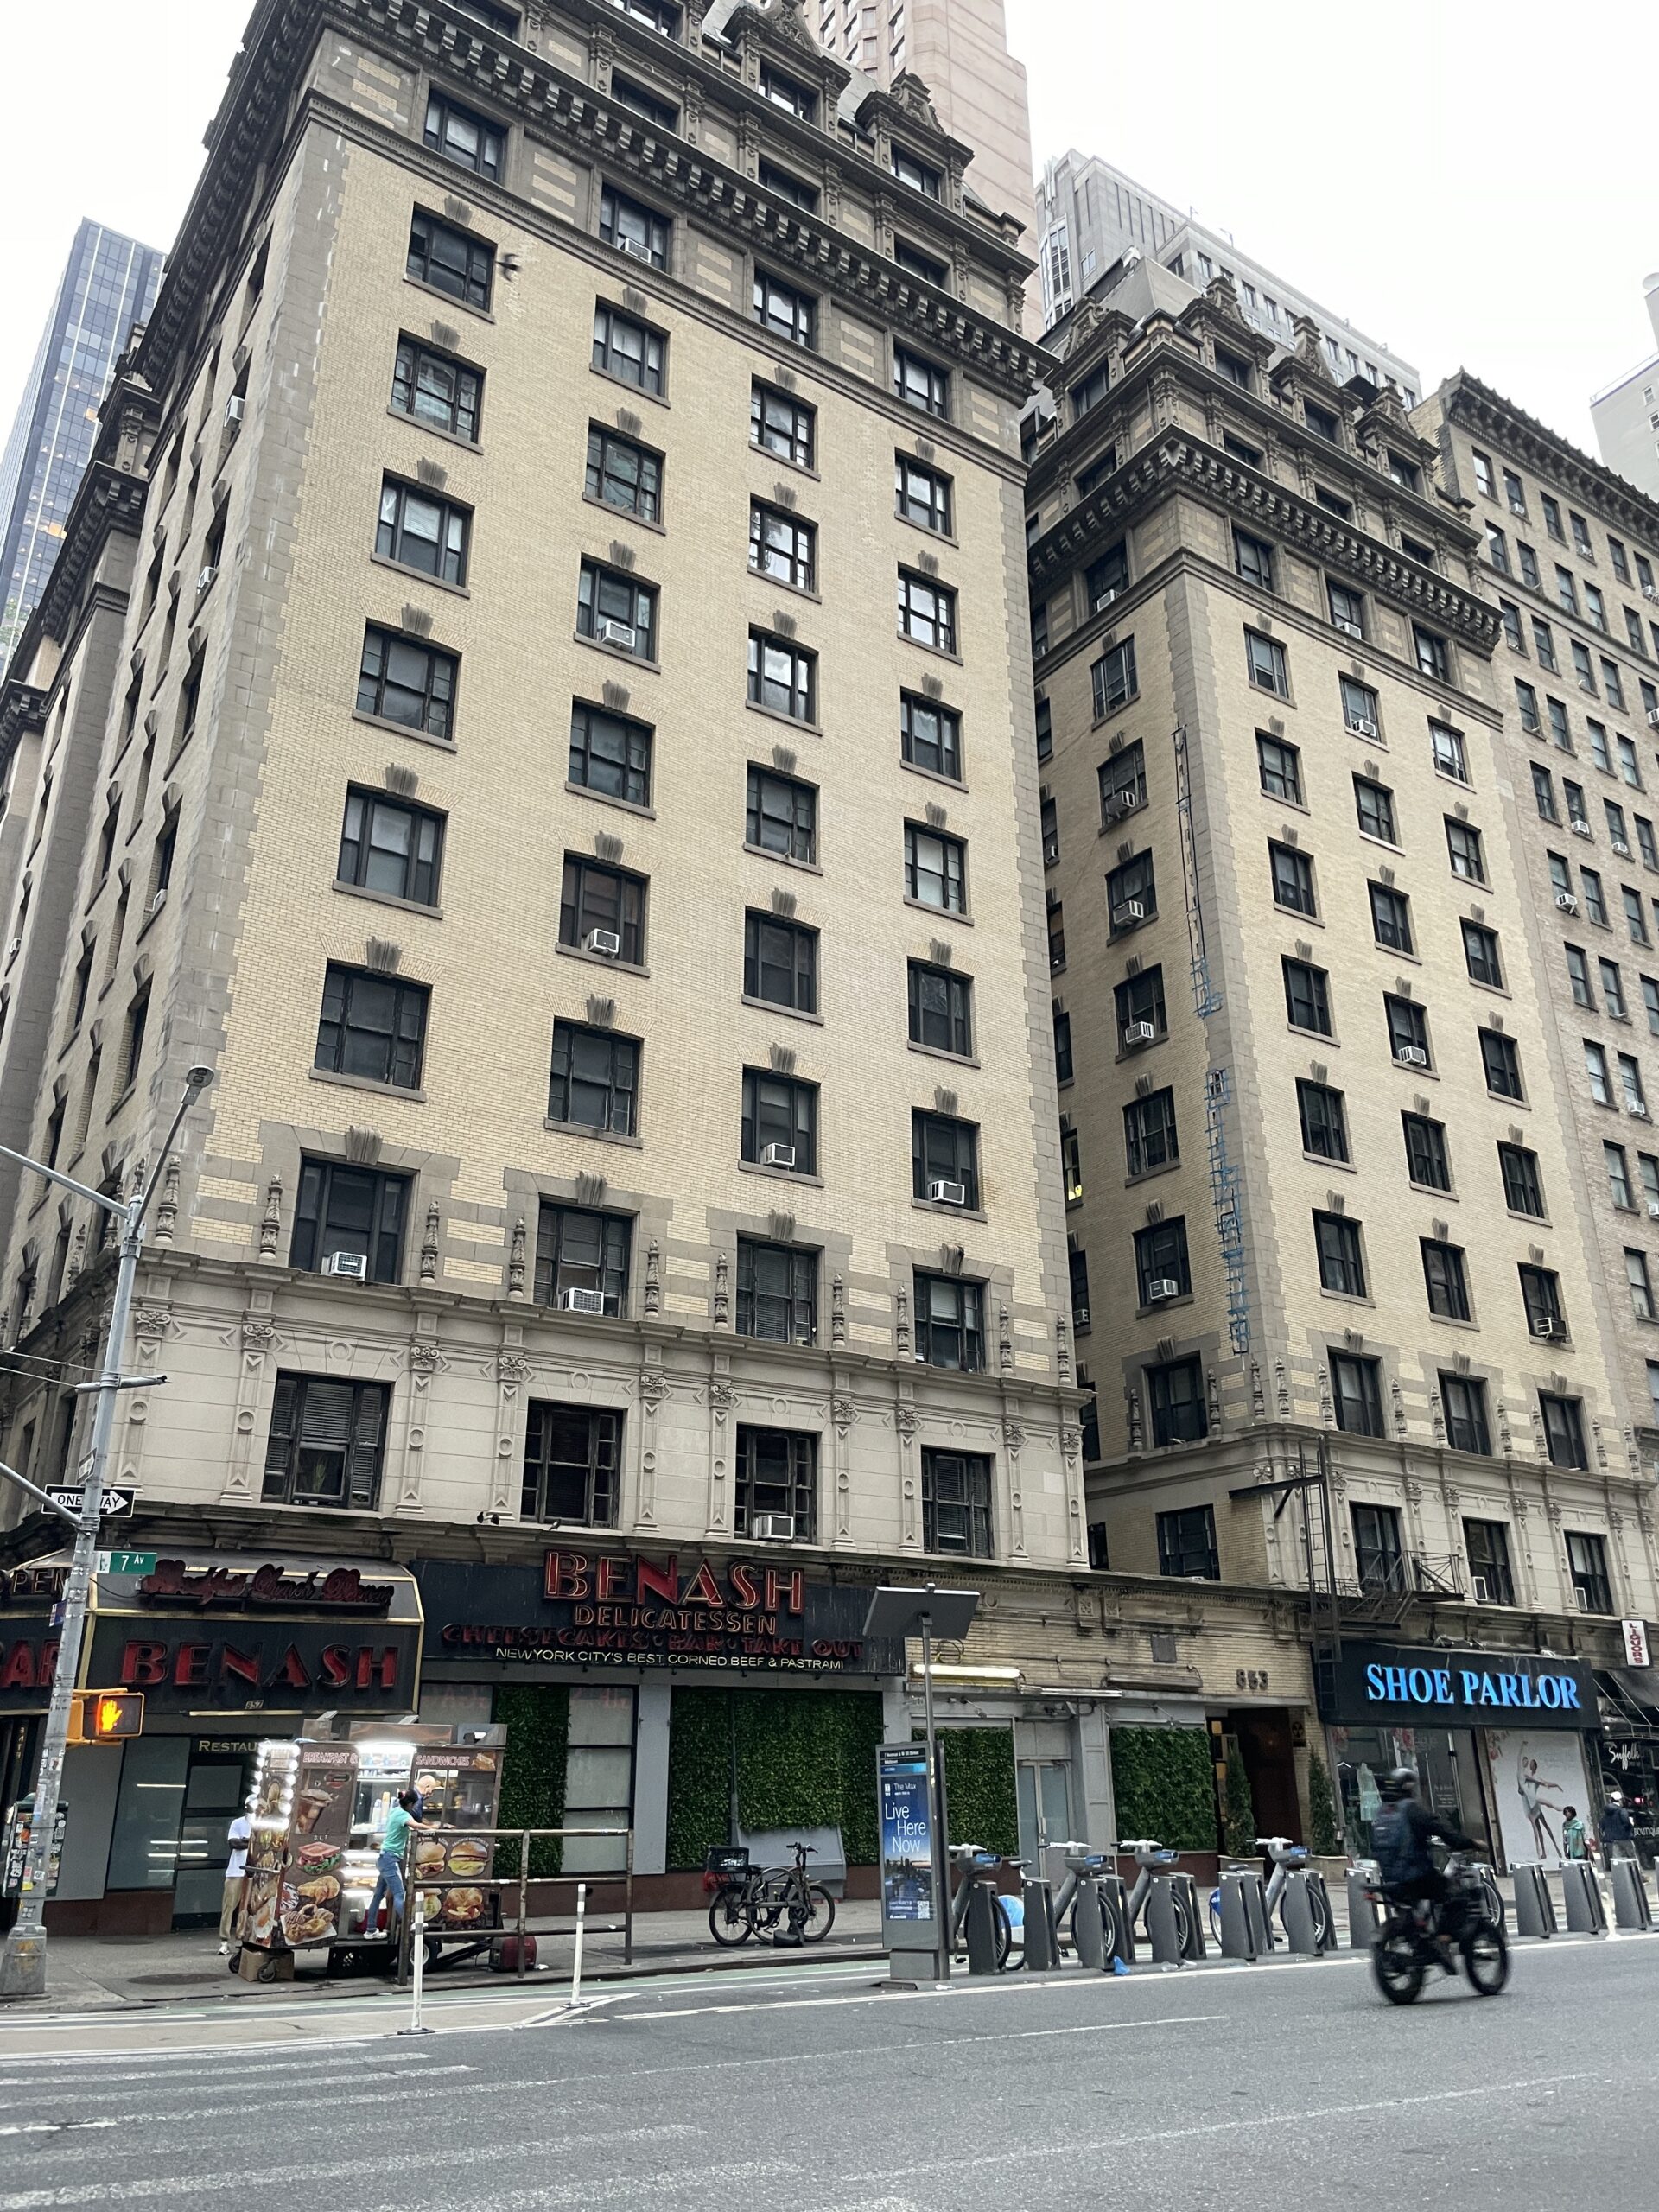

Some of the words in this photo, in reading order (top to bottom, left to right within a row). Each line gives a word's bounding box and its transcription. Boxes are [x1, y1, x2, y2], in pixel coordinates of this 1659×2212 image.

[57, 1494, 82, 1506] ONE
[121, 1555, 129, 1571] 7
[134, 1556, 144, 1565] Av
[0, 1570, 68, 1595] PEN
[543, 1548, 805, 1614] BENASH
[575, 1605, 776, 1635] DELICATESSEN
[812, 1638, 864, 1659] OUT
[1629, 1623, 1643, 1663] LIQUORS
[0, 1639, 60, 1687] AR
[120, 1640, 399, 1688] BENASH
[577, 1651, 623, 1662] CITY'S
[627, 1653, 664, 1664] BEST
[668, 1654, 728, 1666] CORNED
[731, 1656, 765, 1667] BEEF
[768, 1658, 778, 1668] &
[780, 1658, 844, 1669] PASTRAMI
[1236, 1669, 1268, 1689] 853
[1367, 1663, 1454, 1704] SHOE
[1459, 1669, 1581, 1709] PARLOR
[303, 1752, 349, 1764] BREAKFAST
[416, 1755, 470, 1767] SANDWICHES
[885, 1802, 910, 1820] Live
[897, 1820, 926, 1836] Here
[893, 1836, 921, 1853] Now
